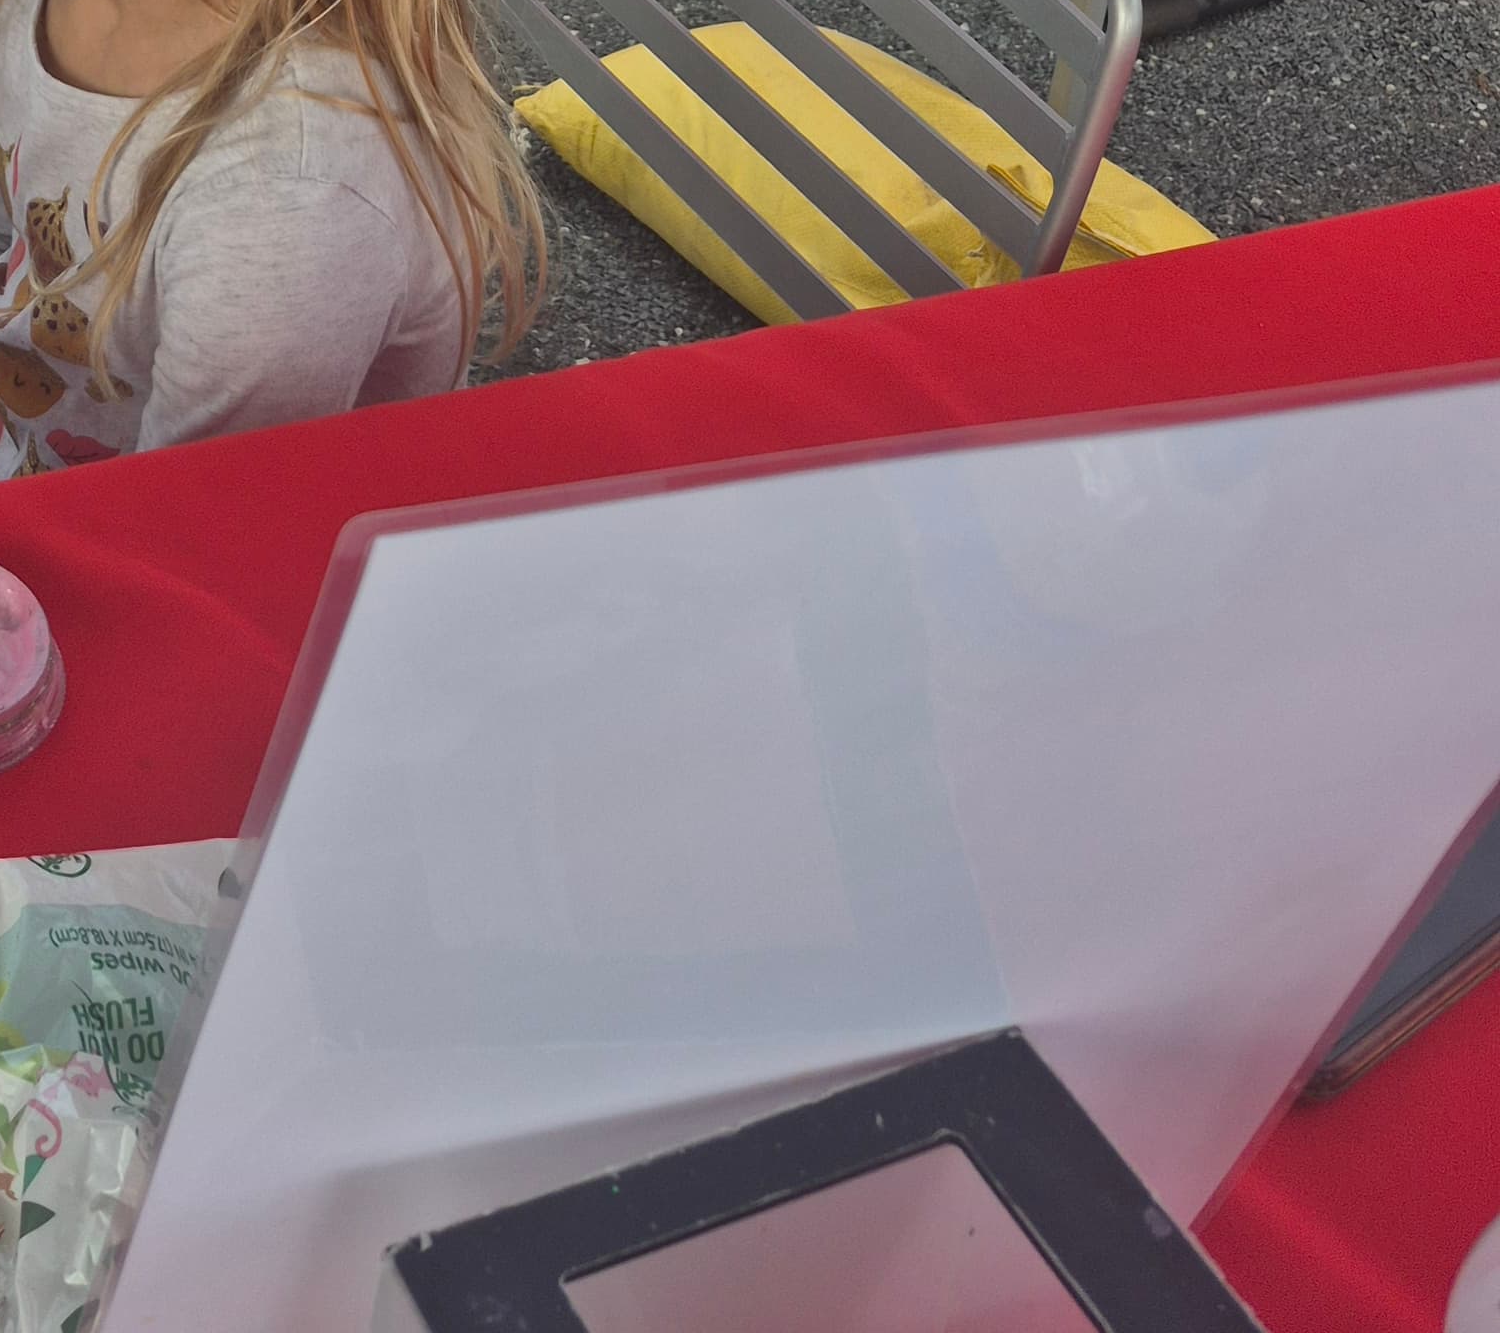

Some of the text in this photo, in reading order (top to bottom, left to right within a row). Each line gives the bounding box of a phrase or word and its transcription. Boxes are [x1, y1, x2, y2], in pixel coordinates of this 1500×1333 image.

[49, 927, 109, 948] 18.8cm)
[91, 951, 166, 975] wipes
[71, 997, 155, 1031] FLUSH
[127, 1031, 165, 1063] DO
